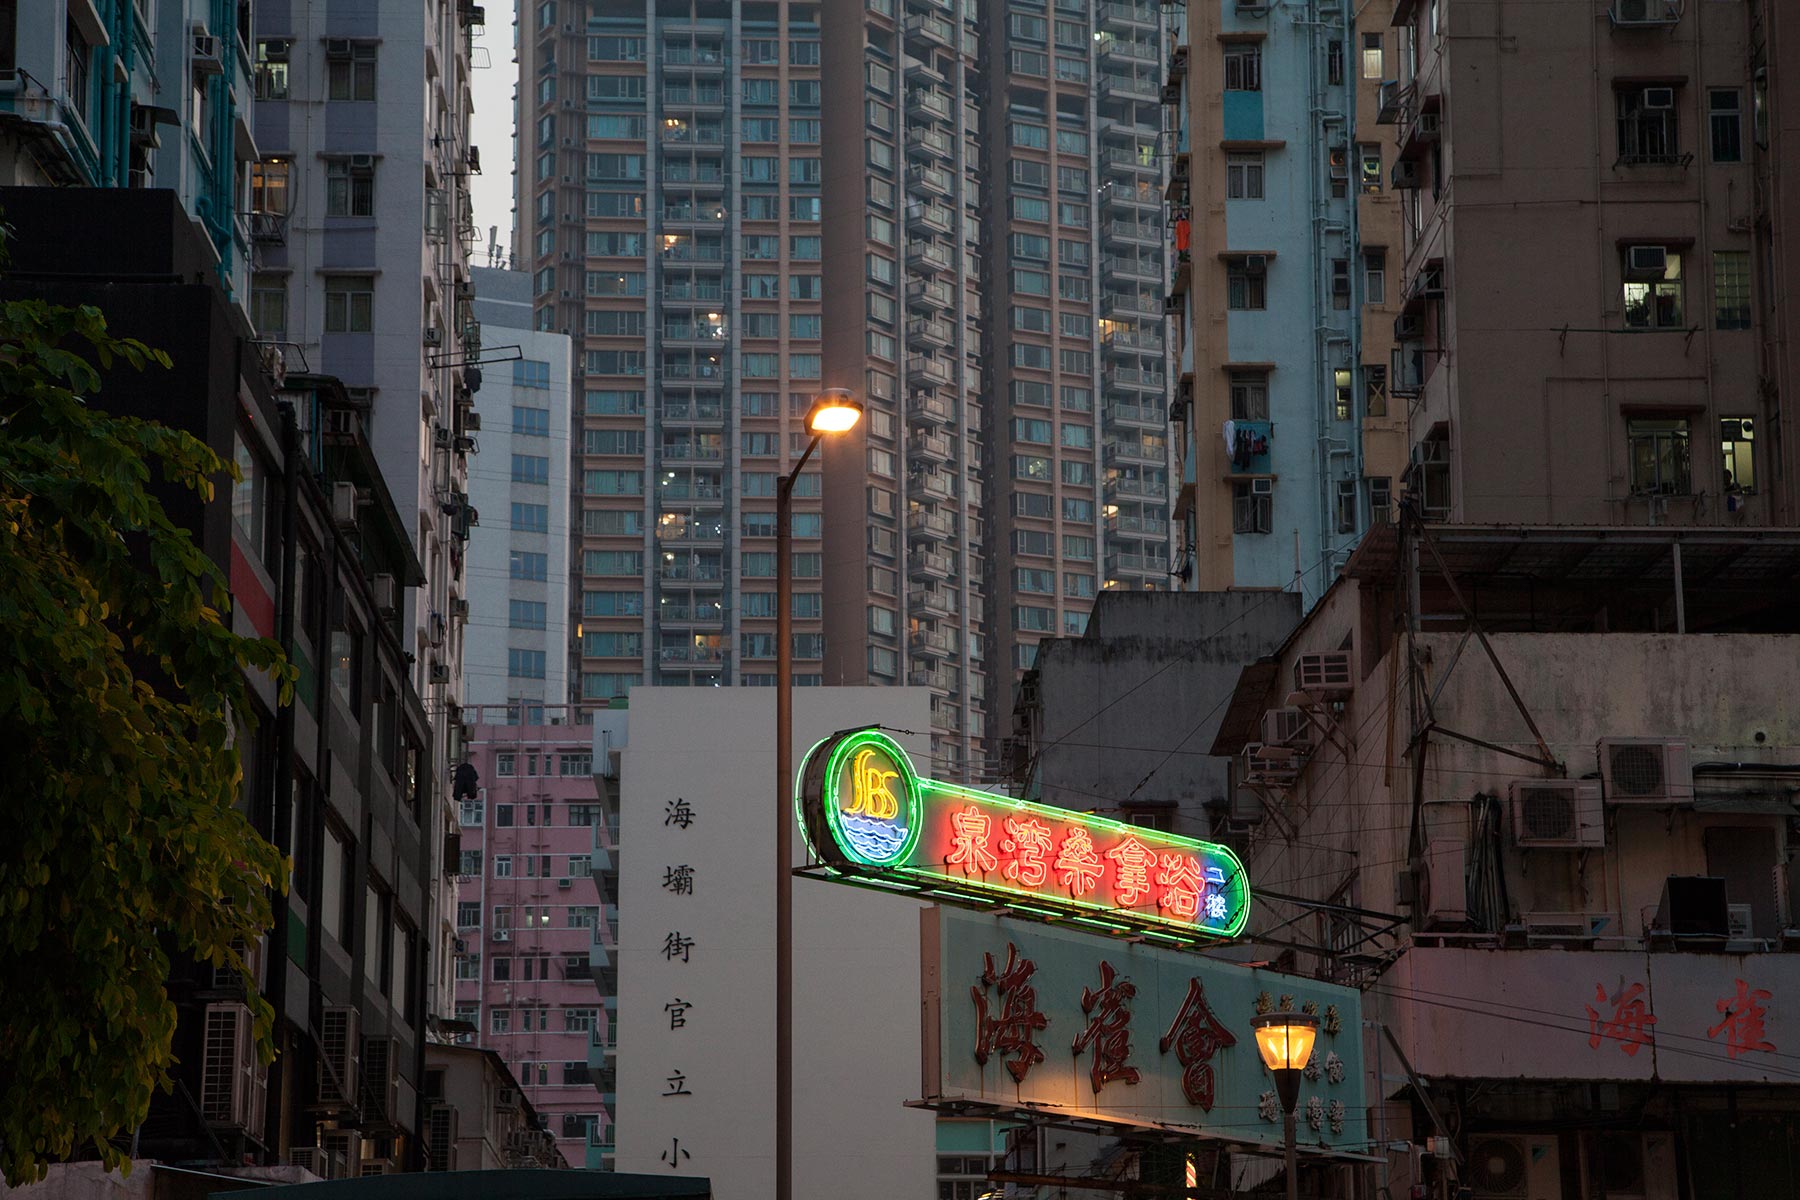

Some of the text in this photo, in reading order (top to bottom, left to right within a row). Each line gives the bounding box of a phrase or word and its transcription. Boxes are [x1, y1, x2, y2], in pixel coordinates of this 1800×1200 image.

[946, 805, 1206, 917] 泉灣桑拿浴
[661, 798, 696, 1169] 海壩街官立小
